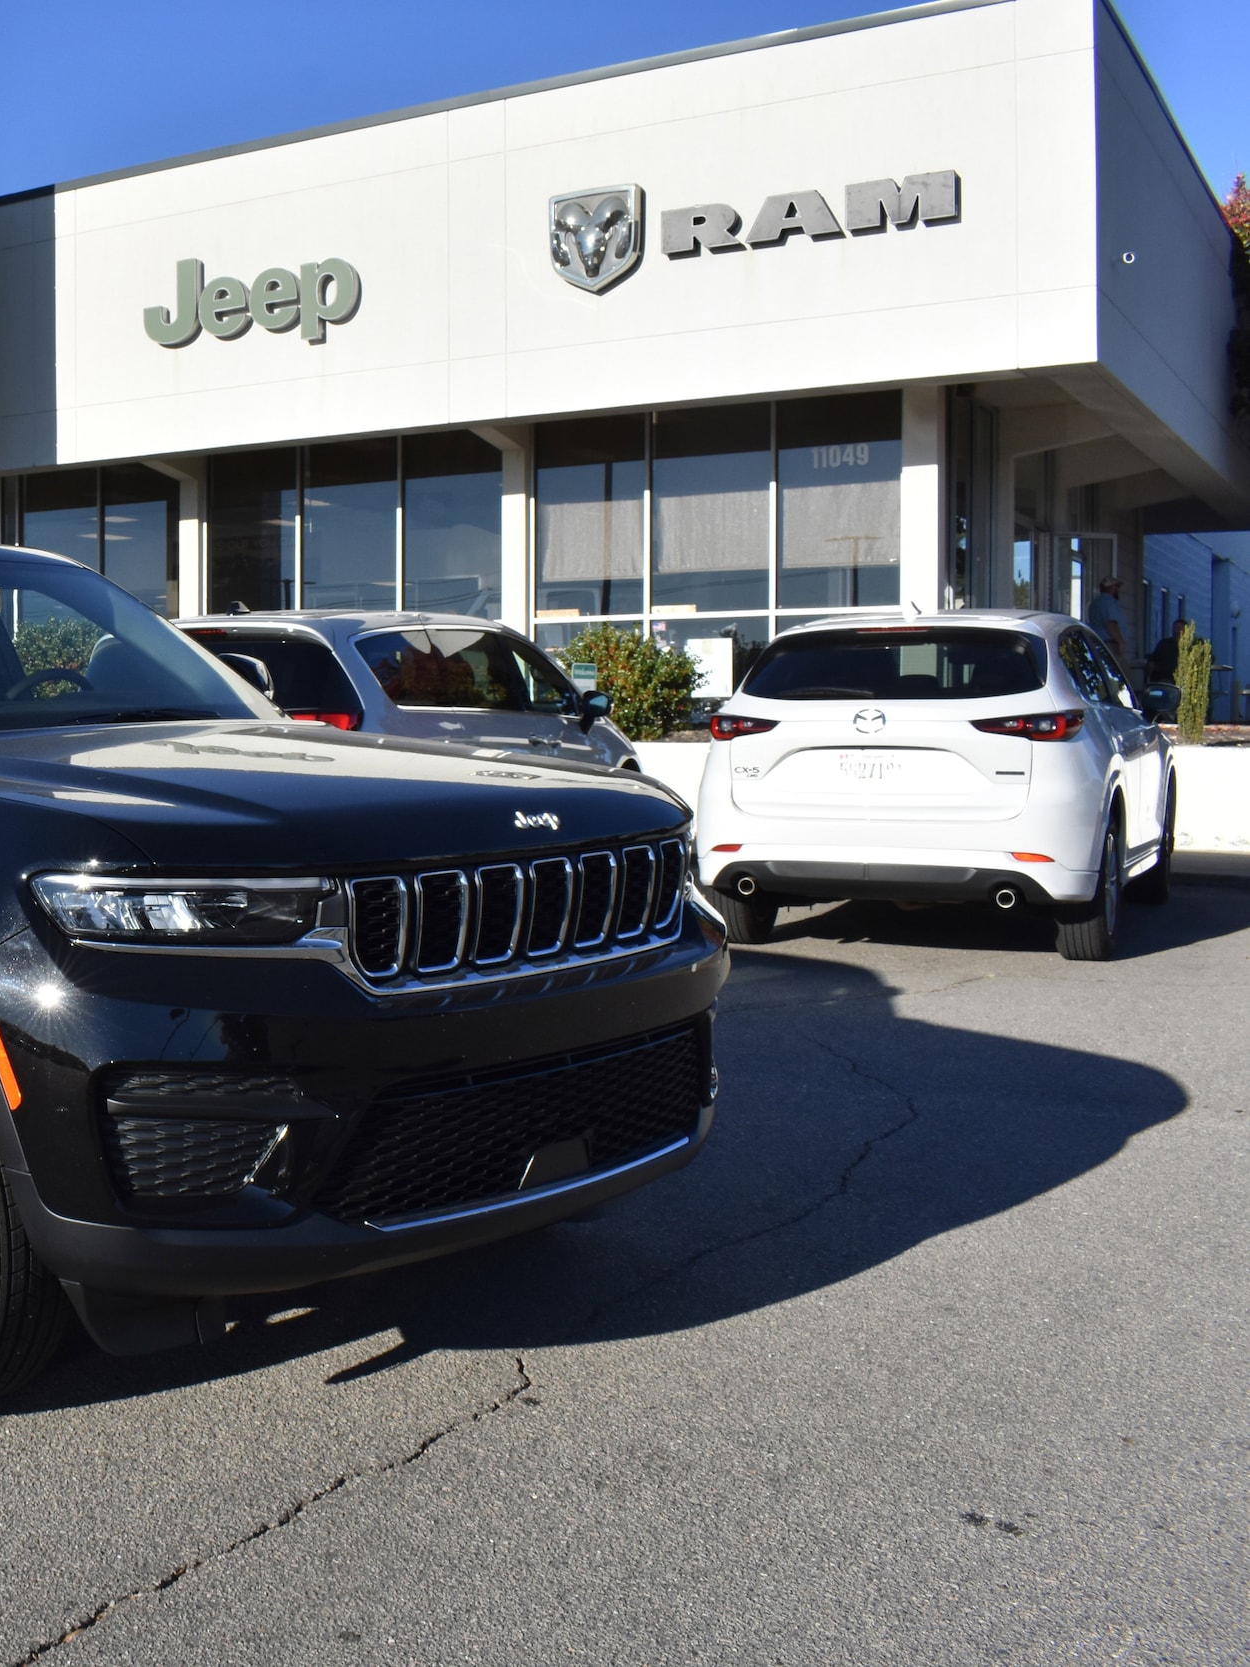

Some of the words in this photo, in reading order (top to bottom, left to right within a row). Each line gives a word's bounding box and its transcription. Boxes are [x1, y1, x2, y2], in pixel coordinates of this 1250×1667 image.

[661, 169, 962, 260] RAM
[143, 257, 363, 349] Jeep
[812, 443, 869, 469] 11049
[734, 766, 760, 774] CX-5
[514, 811, 560, 831] Jeep
